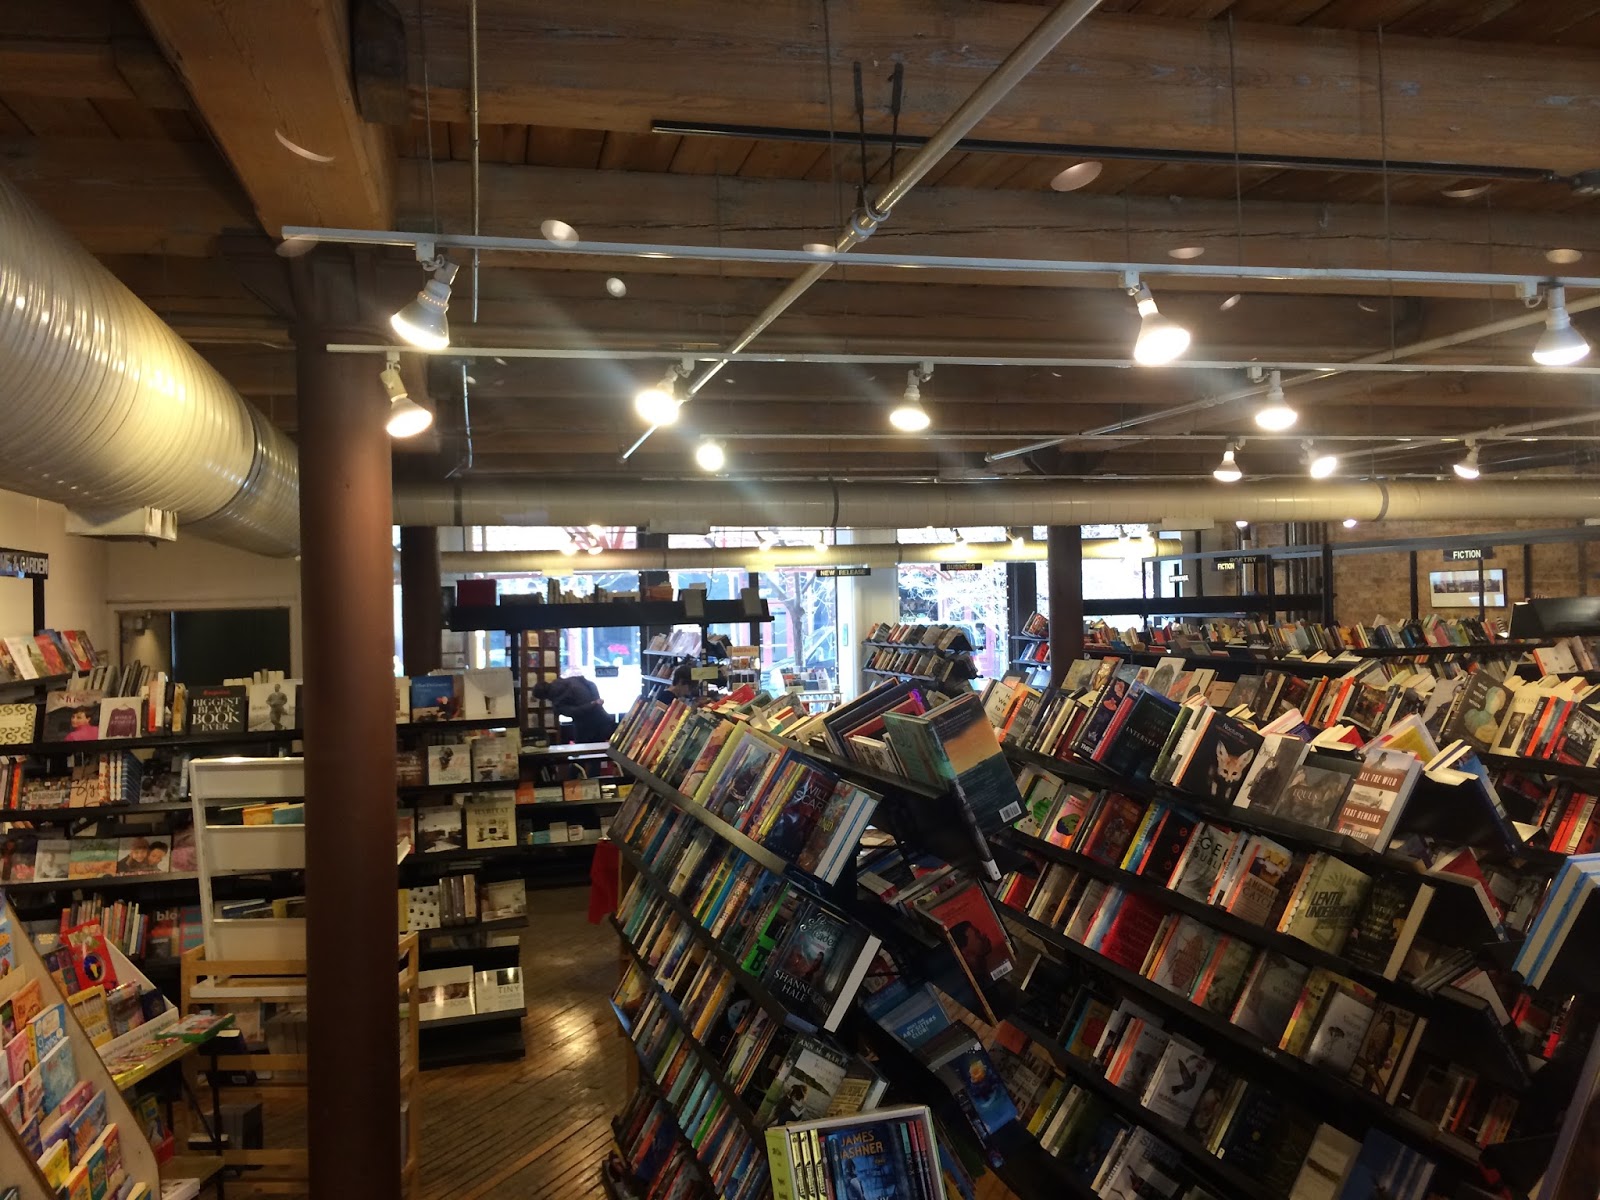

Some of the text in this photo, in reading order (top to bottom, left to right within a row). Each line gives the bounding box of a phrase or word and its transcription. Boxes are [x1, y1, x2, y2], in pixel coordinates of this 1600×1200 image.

[1229, 556, 1257, 564] POETRY
[1453, 550, 1482, 559] FICTION
[20, 556, 48, 575] GARDEN
[1217, 563, 1235, 571] FICTION
[820, 569, 835, 577] NEW
[193, 697, 240, 708] BIGGEST
[198, 705, 234, 714] BLACK
[192, 712, 240, 725] BOOK
[202, 724, 229, 732] EVER
[1222, 723, 1246, 740] Nocturne
[1360, 772, 1398, 787] ALL THE WILD
[474, 807, 509, 815] HABITAT
[1343, 807, 1381, 823] THAT REMAINS
[498, 985, 519, 993] TINY
[781, 984, 808, 1003] HALE
[799, 1039, 815, 1050] ANN
[841, 1130, 875, 1148] JAMES
